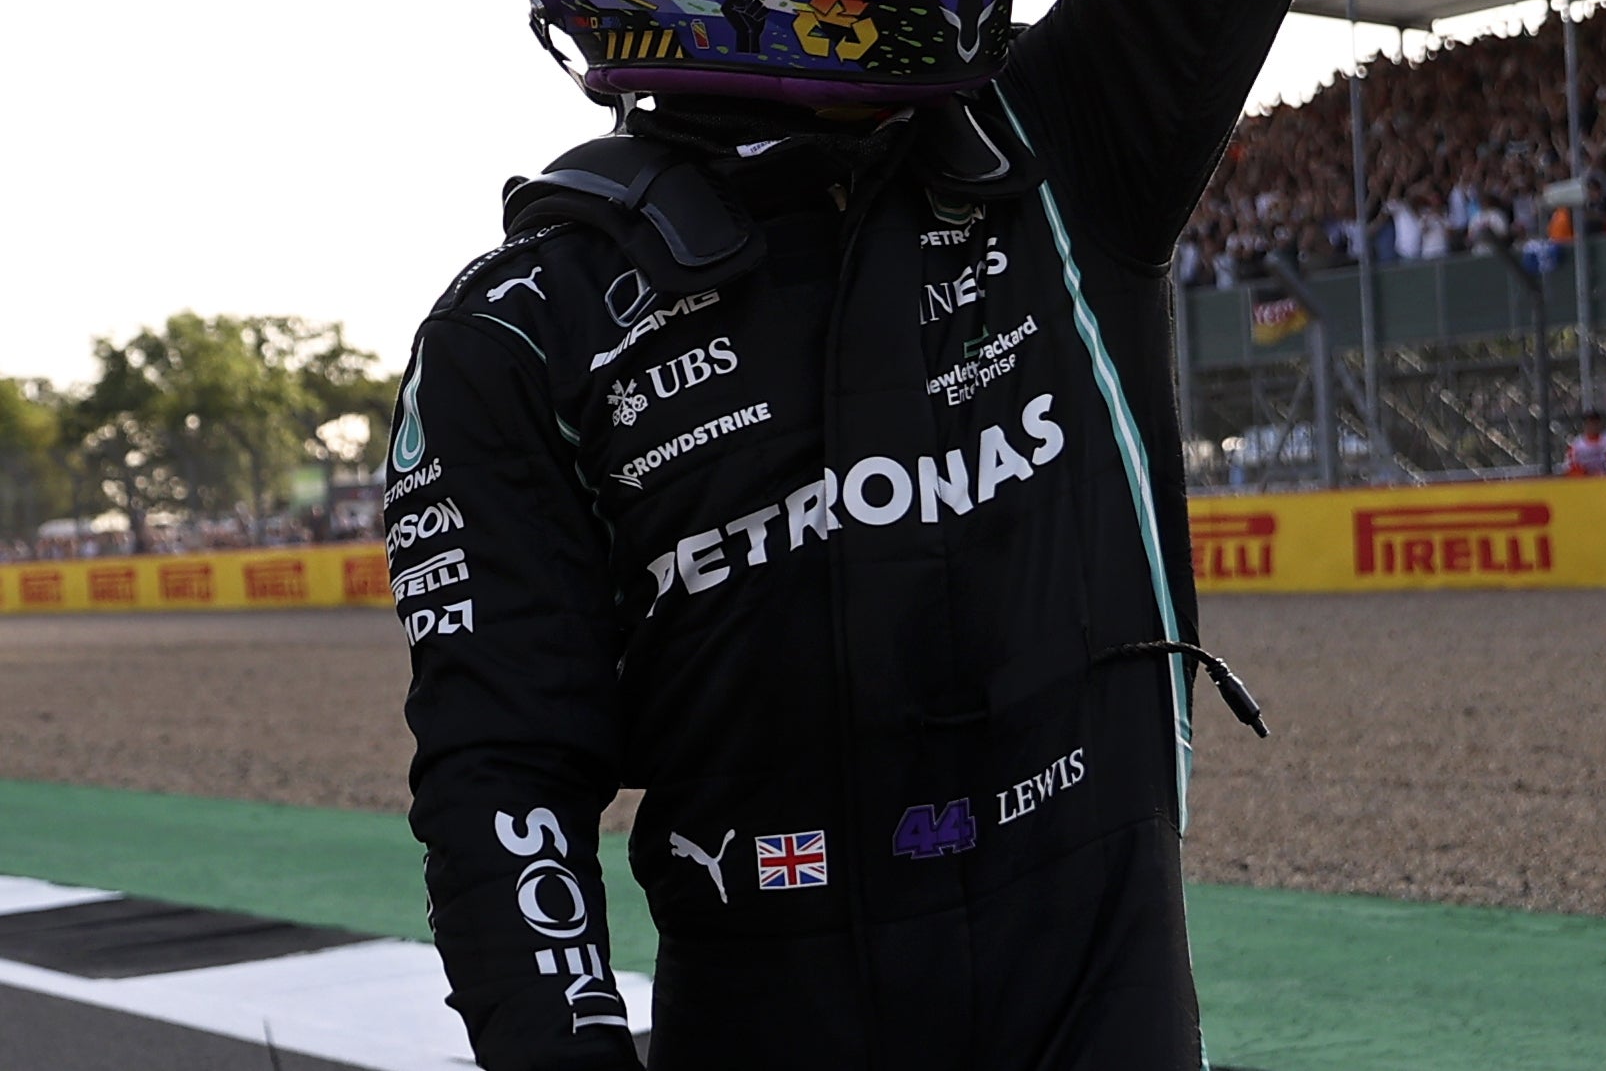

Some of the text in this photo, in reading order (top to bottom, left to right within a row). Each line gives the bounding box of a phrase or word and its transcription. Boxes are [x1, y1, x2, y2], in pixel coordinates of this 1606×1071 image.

[646, 337, 738, 400] UBS
[926, 360, 981, 396] ewlett
[622, 402, 772, 480] CROWDSTRIKE
[383, 457, 443, 513] ETRONAS
[1353, 502, 1552, 576] PIRELLI
[998, 747, 1086, 826] LEWIS
[892, 797, 977, 860] 44
[494, 806, 628, 1036] INEOS
